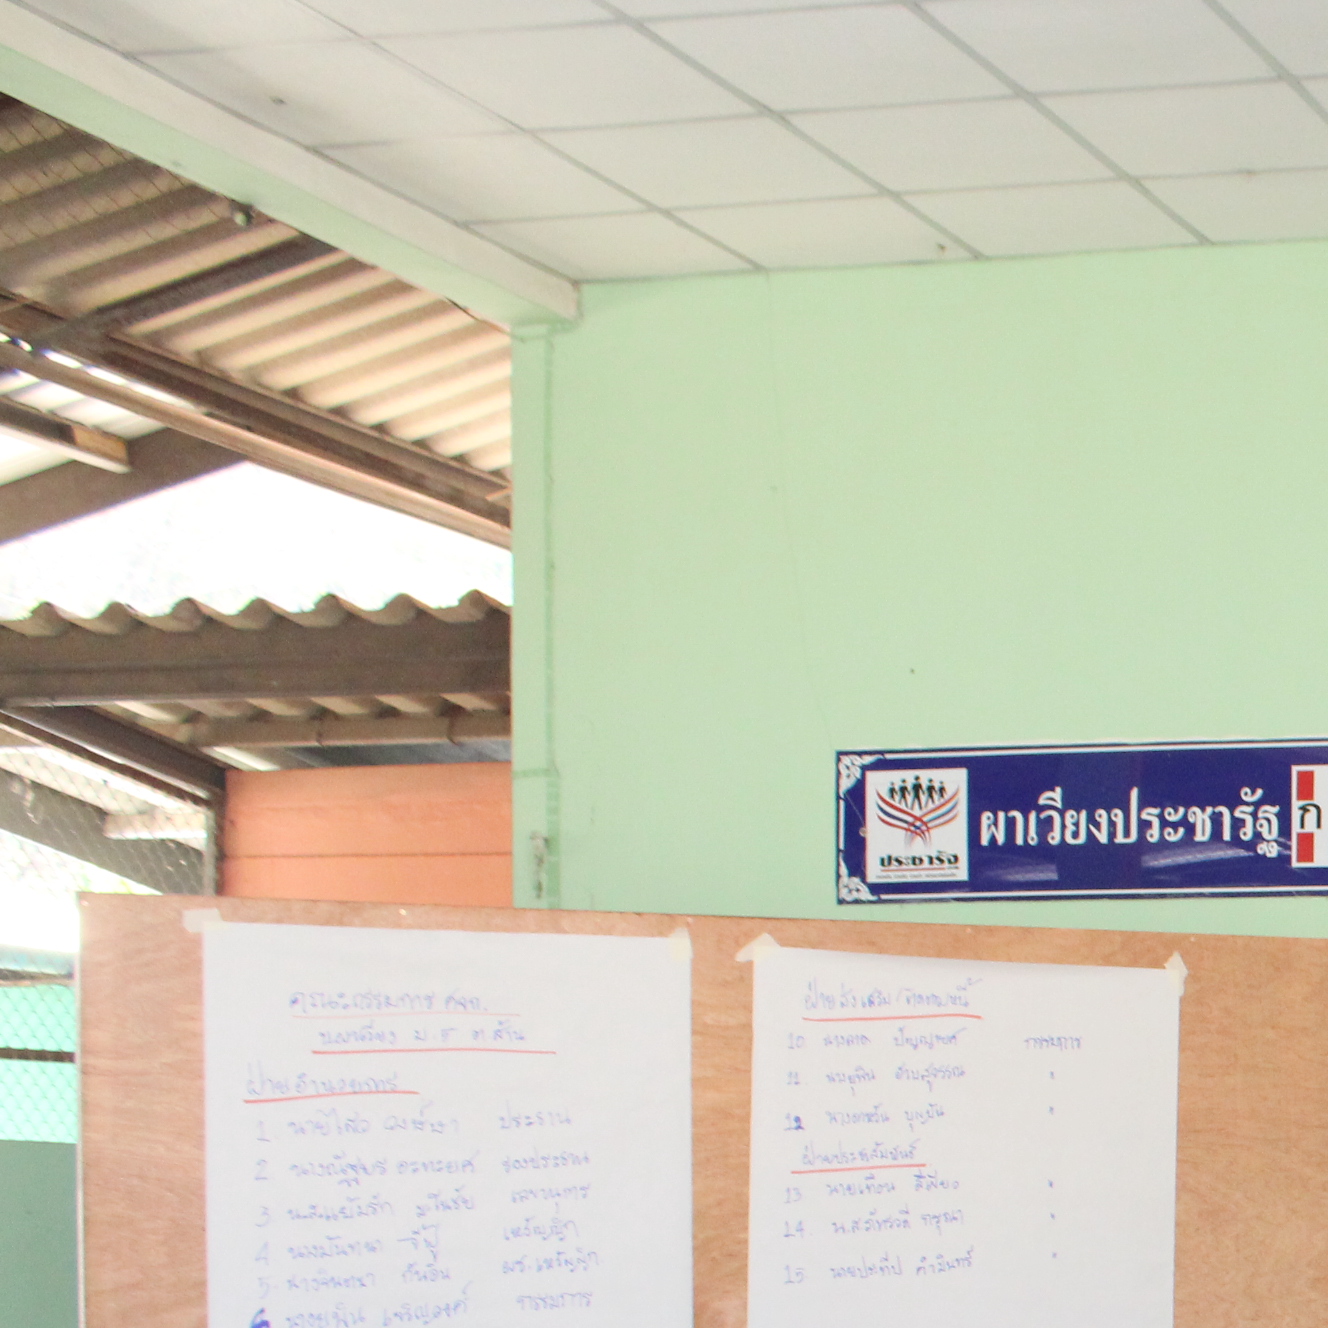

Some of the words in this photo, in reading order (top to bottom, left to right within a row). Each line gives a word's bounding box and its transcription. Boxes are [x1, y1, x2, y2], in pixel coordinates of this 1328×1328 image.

[979, 786, 1281, 857] ผาเวียงประชารัฐ
